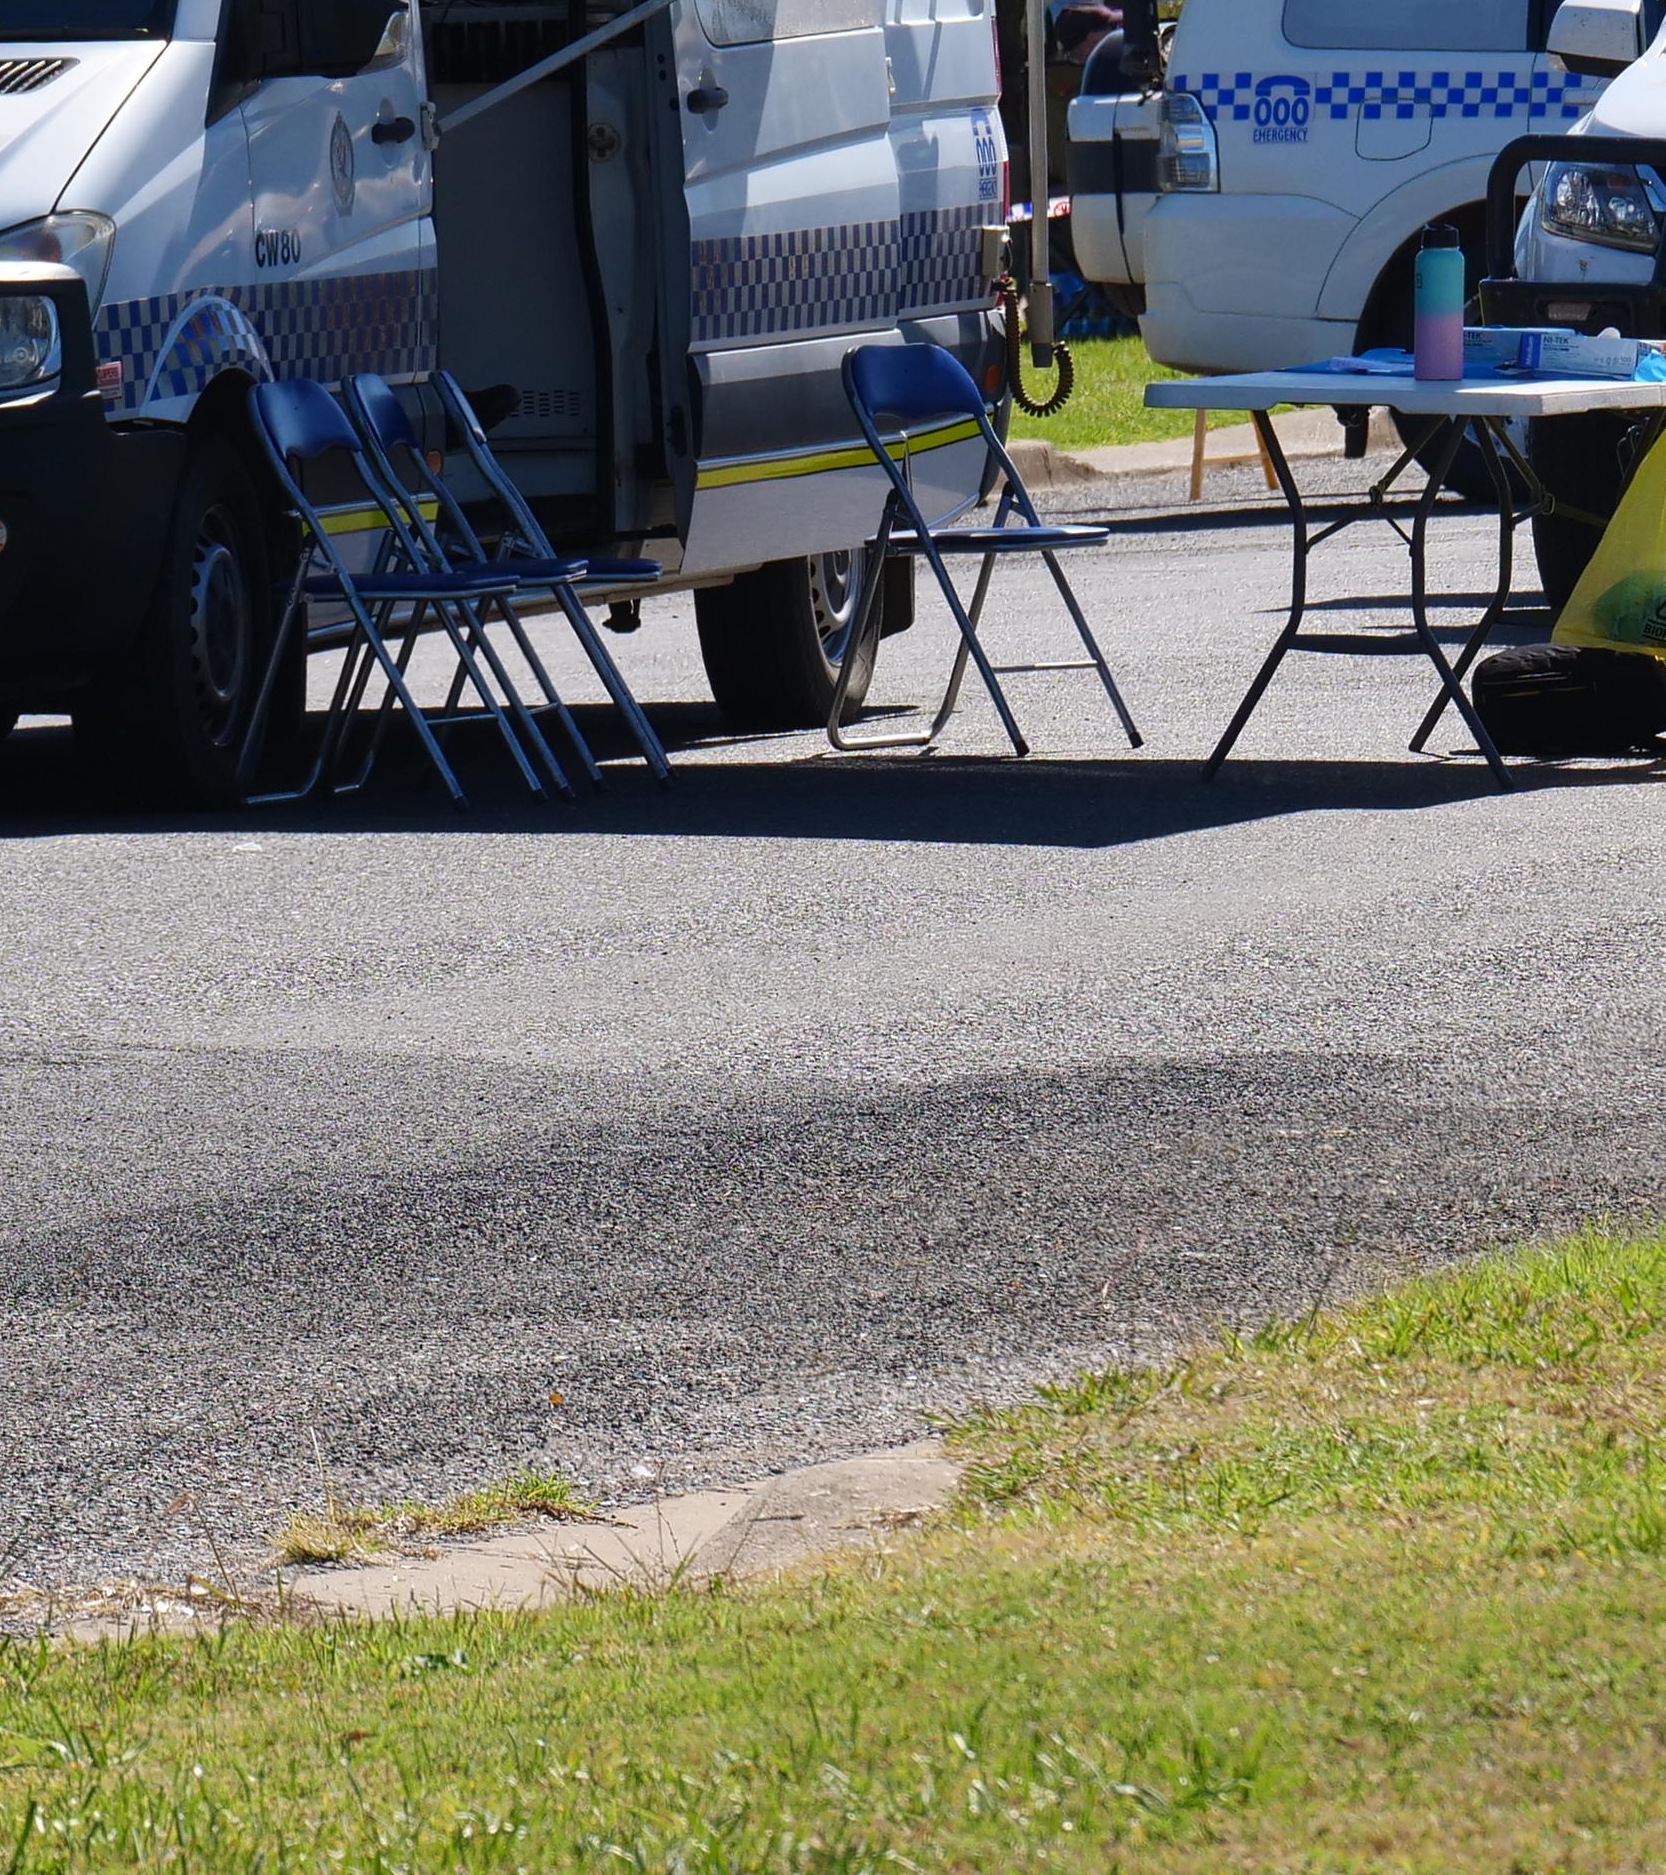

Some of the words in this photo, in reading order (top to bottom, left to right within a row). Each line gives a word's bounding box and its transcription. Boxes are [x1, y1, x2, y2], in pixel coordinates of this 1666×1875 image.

[1254, 97, 1309, 127] 000
[1253, 127, 1308, 143] EMERGENCY
[255, 229, 301, 268] CW80
